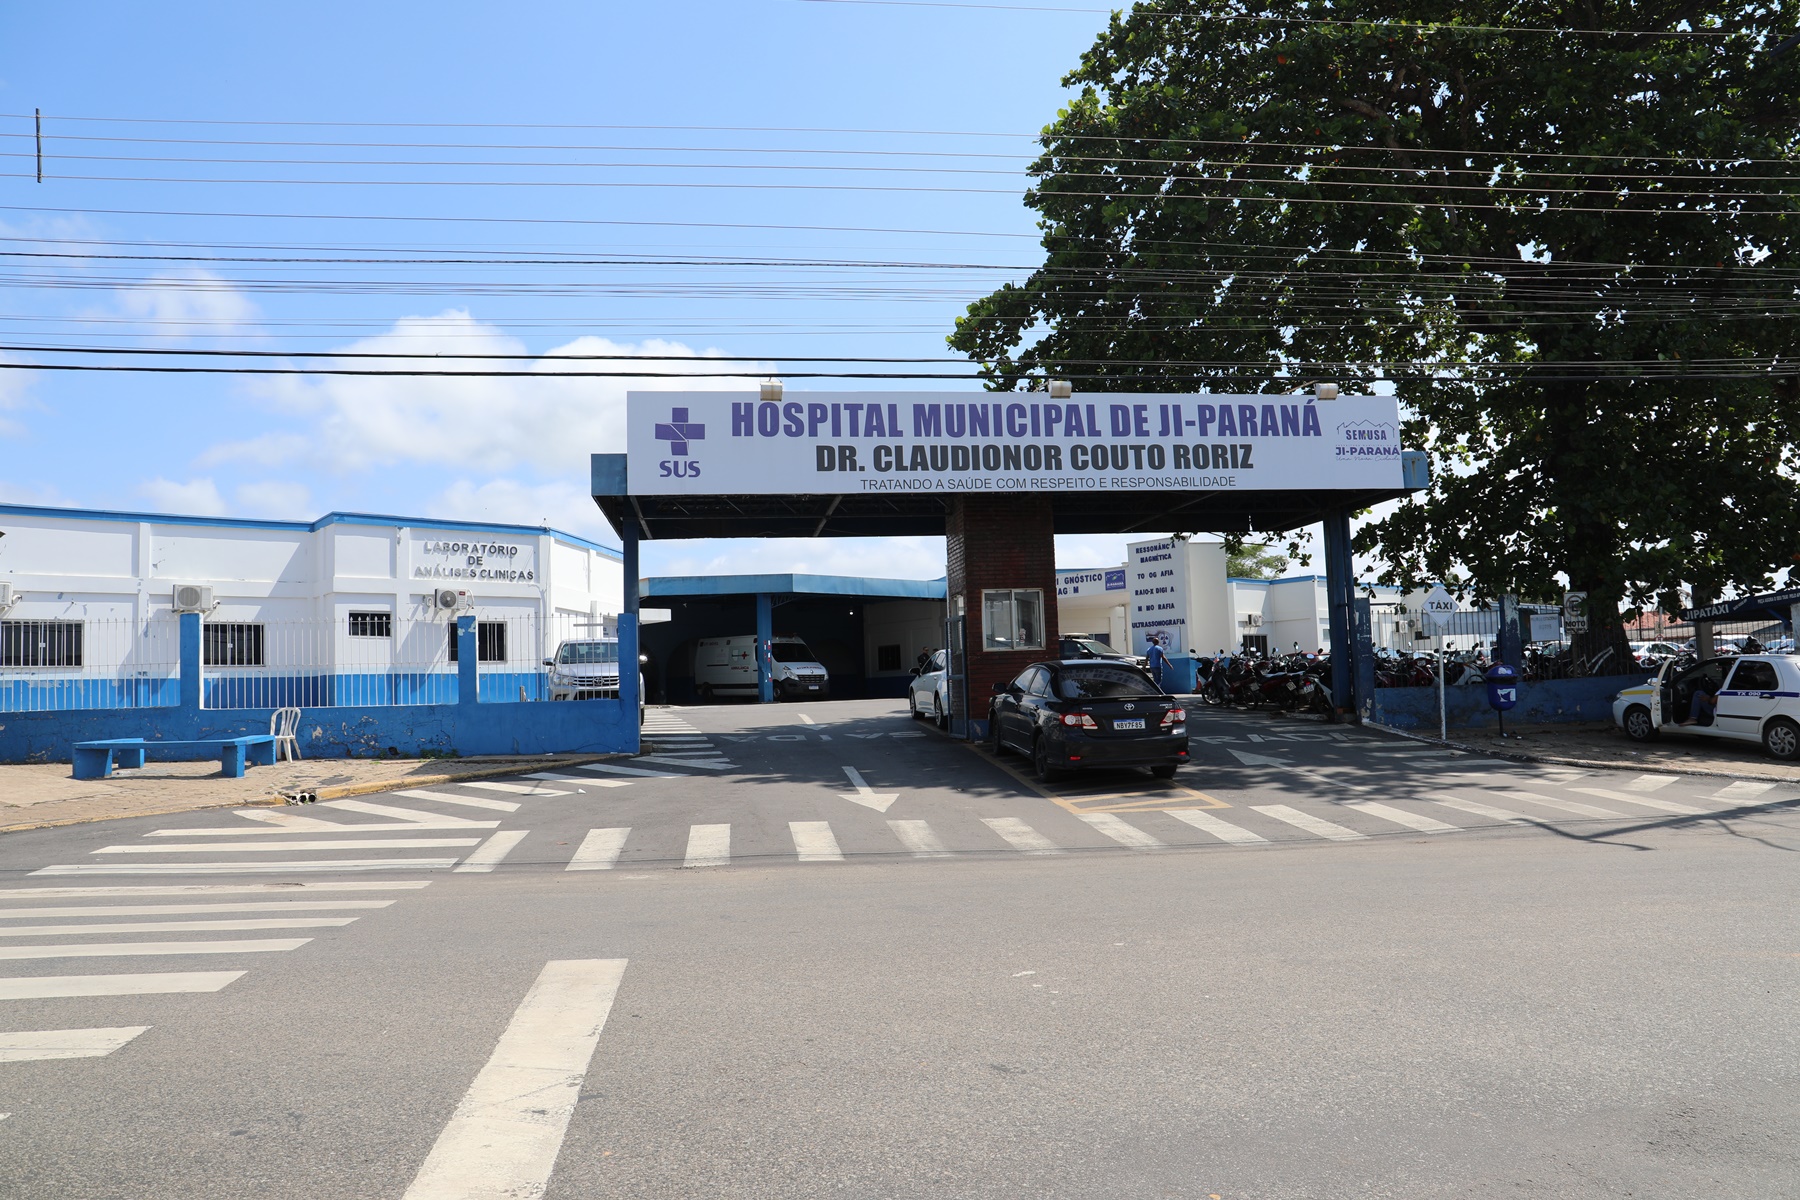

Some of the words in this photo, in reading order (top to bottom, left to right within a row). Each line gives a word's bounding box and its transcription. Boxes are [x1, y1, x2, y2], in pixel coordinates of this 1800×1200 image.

[732, 402, 903, 438] HOSPITAL
[913, 403, 1101, 438] MUNICIPAL
[1110, 404, 1150, 437] DE
[1158, 399, 1322, 437] JI-PARANÁ
[1346, 429, 1387, 441] SEMUSA
[1336, 445, 1400, 456] JI-PARANÁ
[816, 445, 865, 472] DR.
[873, 445, 1062, 472] CLAUDIONOR
[1070, 444, 1165, 471] COUTO
[1173, 444, 1254, 470] RORIZ
[659, 460, 701, 479] SUS
[860, 479, 933, 491] TRATANDO
[935, 479, 945, 490] A
[948, 477, 993, 490] SAÚDE
[996, 478, 1027, 489] COM
[1030, 478, 1096, 489] RESPEITO
[1100, 478, 1108, 488] E
[1111, 476, 1237, 488] RESPONSABILIDADE
[424, 541, 518, 556] LABORATÓRIO
[468, 555, 483, 566] DE
[415, 564, 477, 578] ANÁLISES
[1135, 588, 1154, 596] RAIO-X
[1429, 600, 1453, 610] TÁXI
[1565, 620, 1586, 628] MOTO
[1116, 721, 1143, 729] NBY7F85
